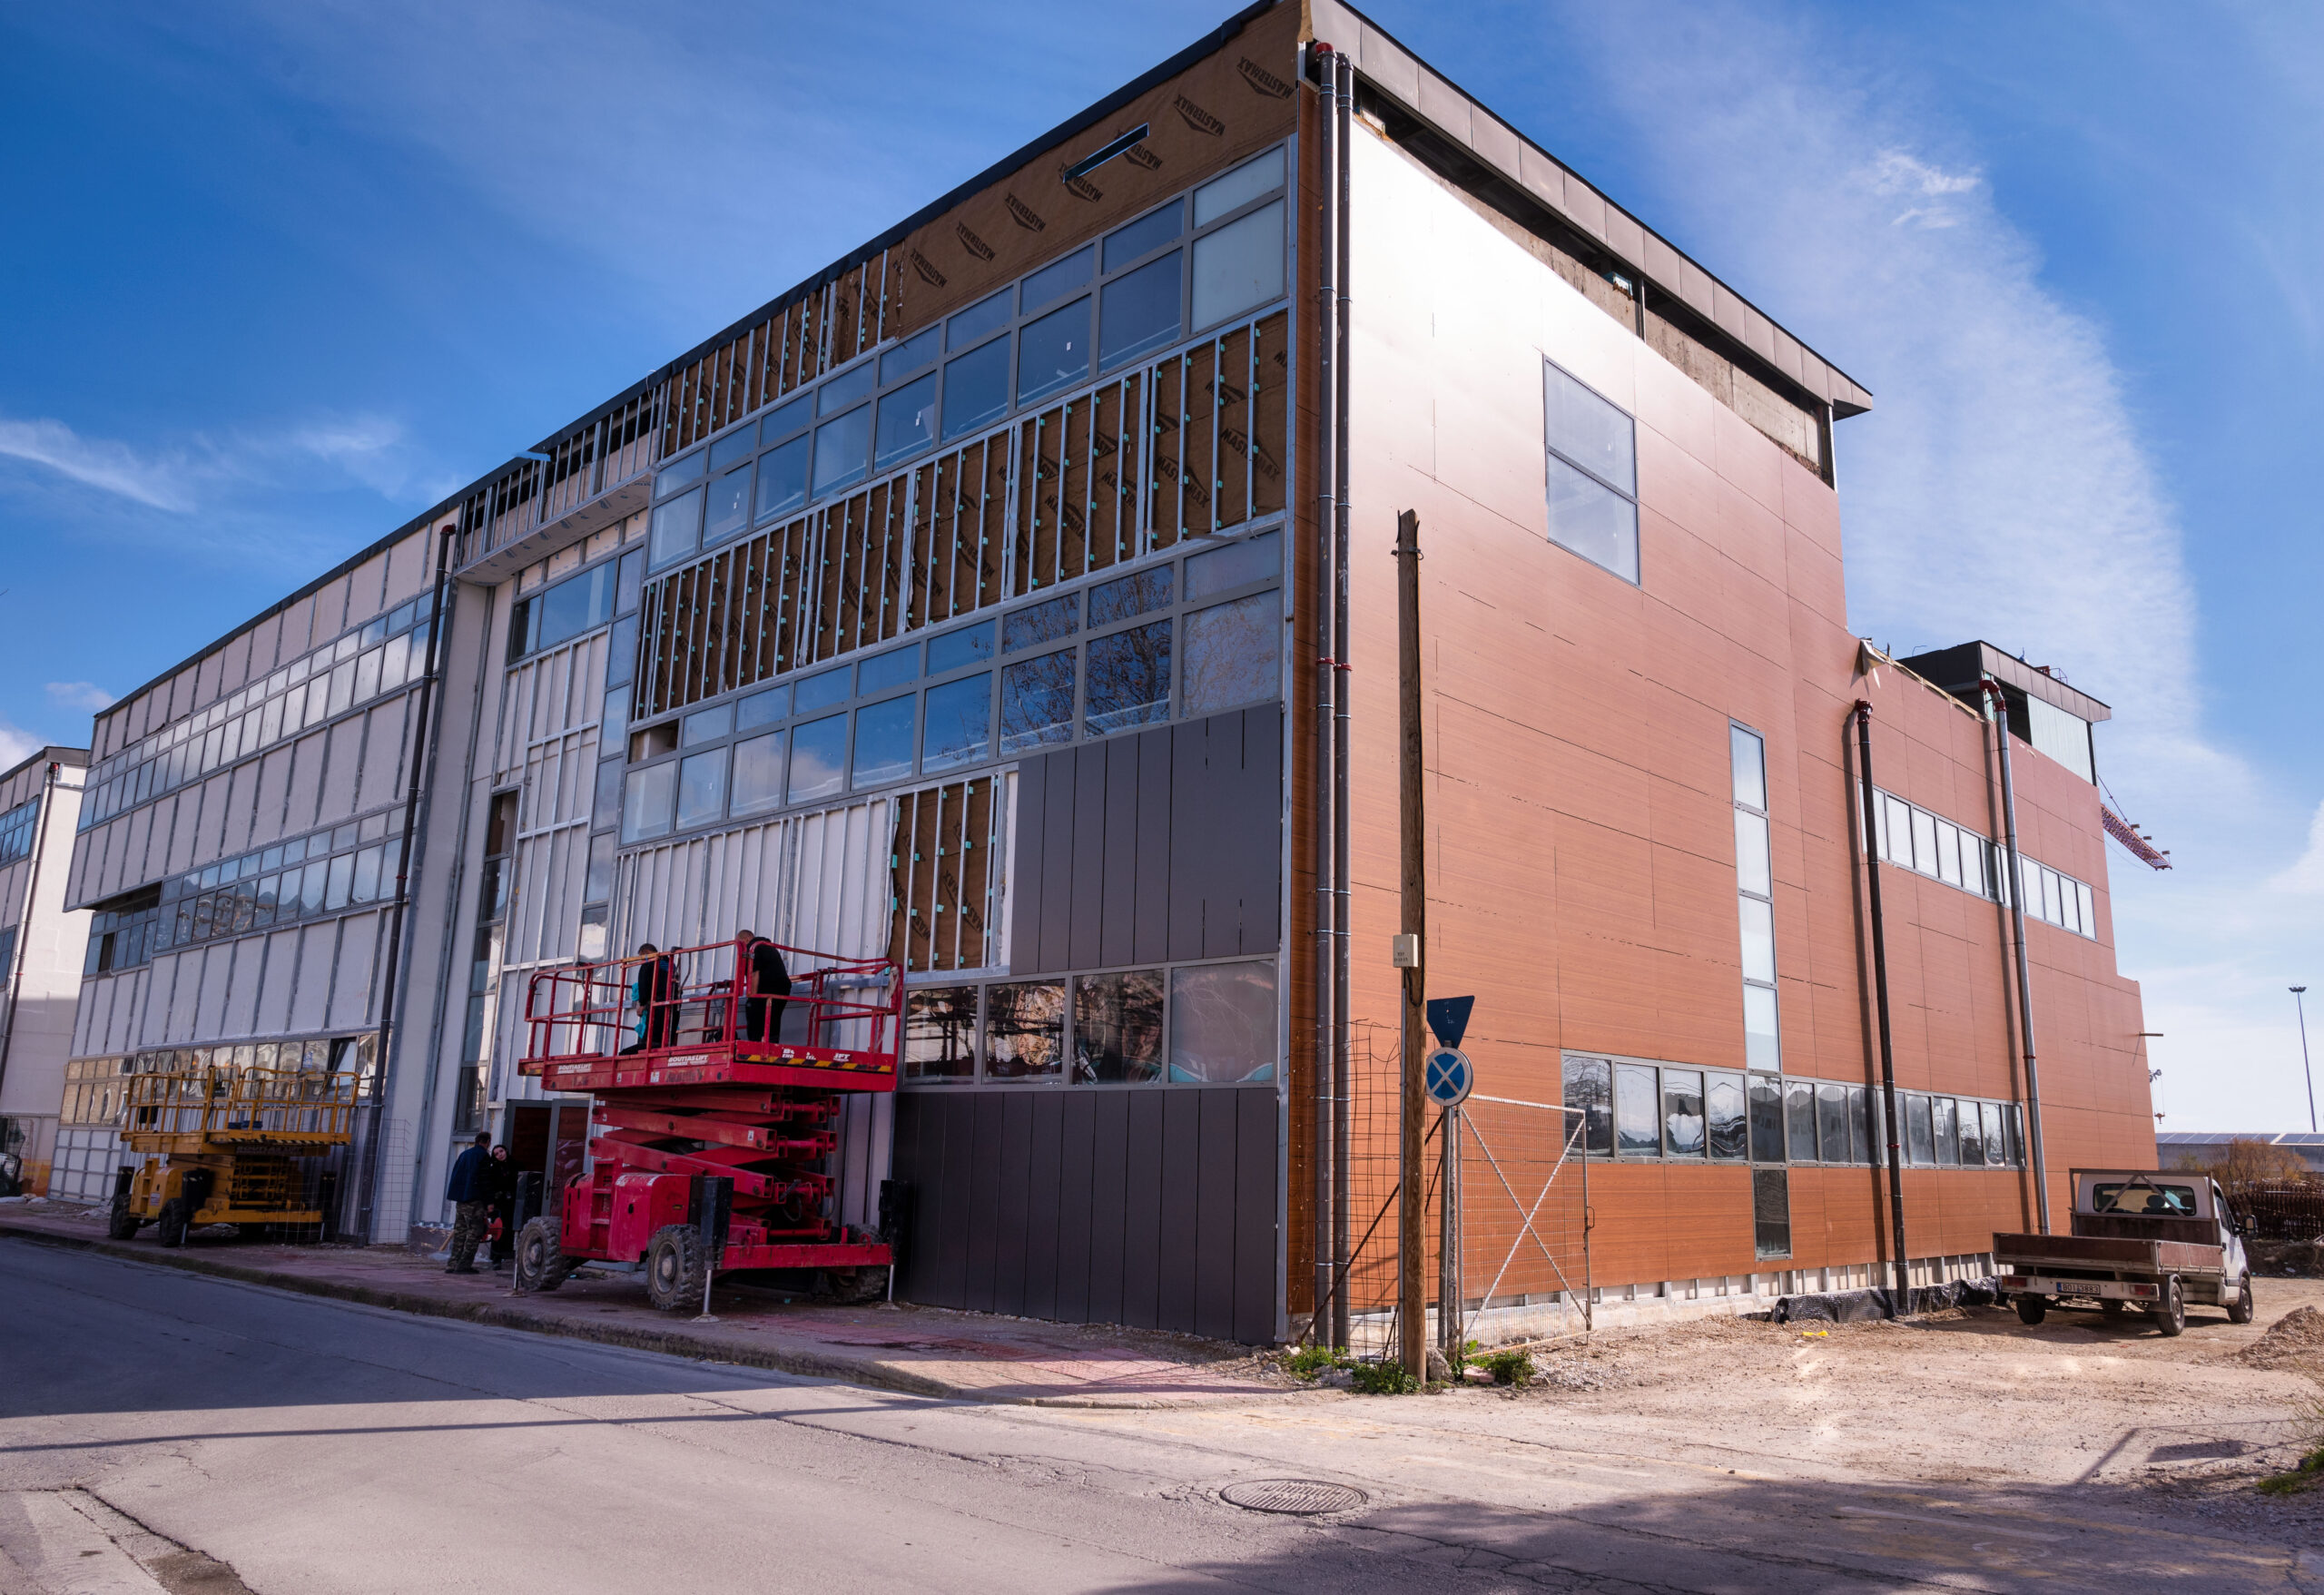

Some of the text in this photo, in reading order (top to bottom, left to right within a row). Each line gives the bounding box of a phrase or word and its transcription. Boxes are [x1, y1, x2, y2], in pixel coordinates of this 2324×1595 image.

[1236, 56, 1295, 99] MASTERMAX
[1173, 94, 1226, 136] MASTERMAX
[1005, 192, 1046, 232] MASTERMAX
[956, 221, 995, 262] MASTERMAX
[910, 248, 948, 288] MASTERMAX
